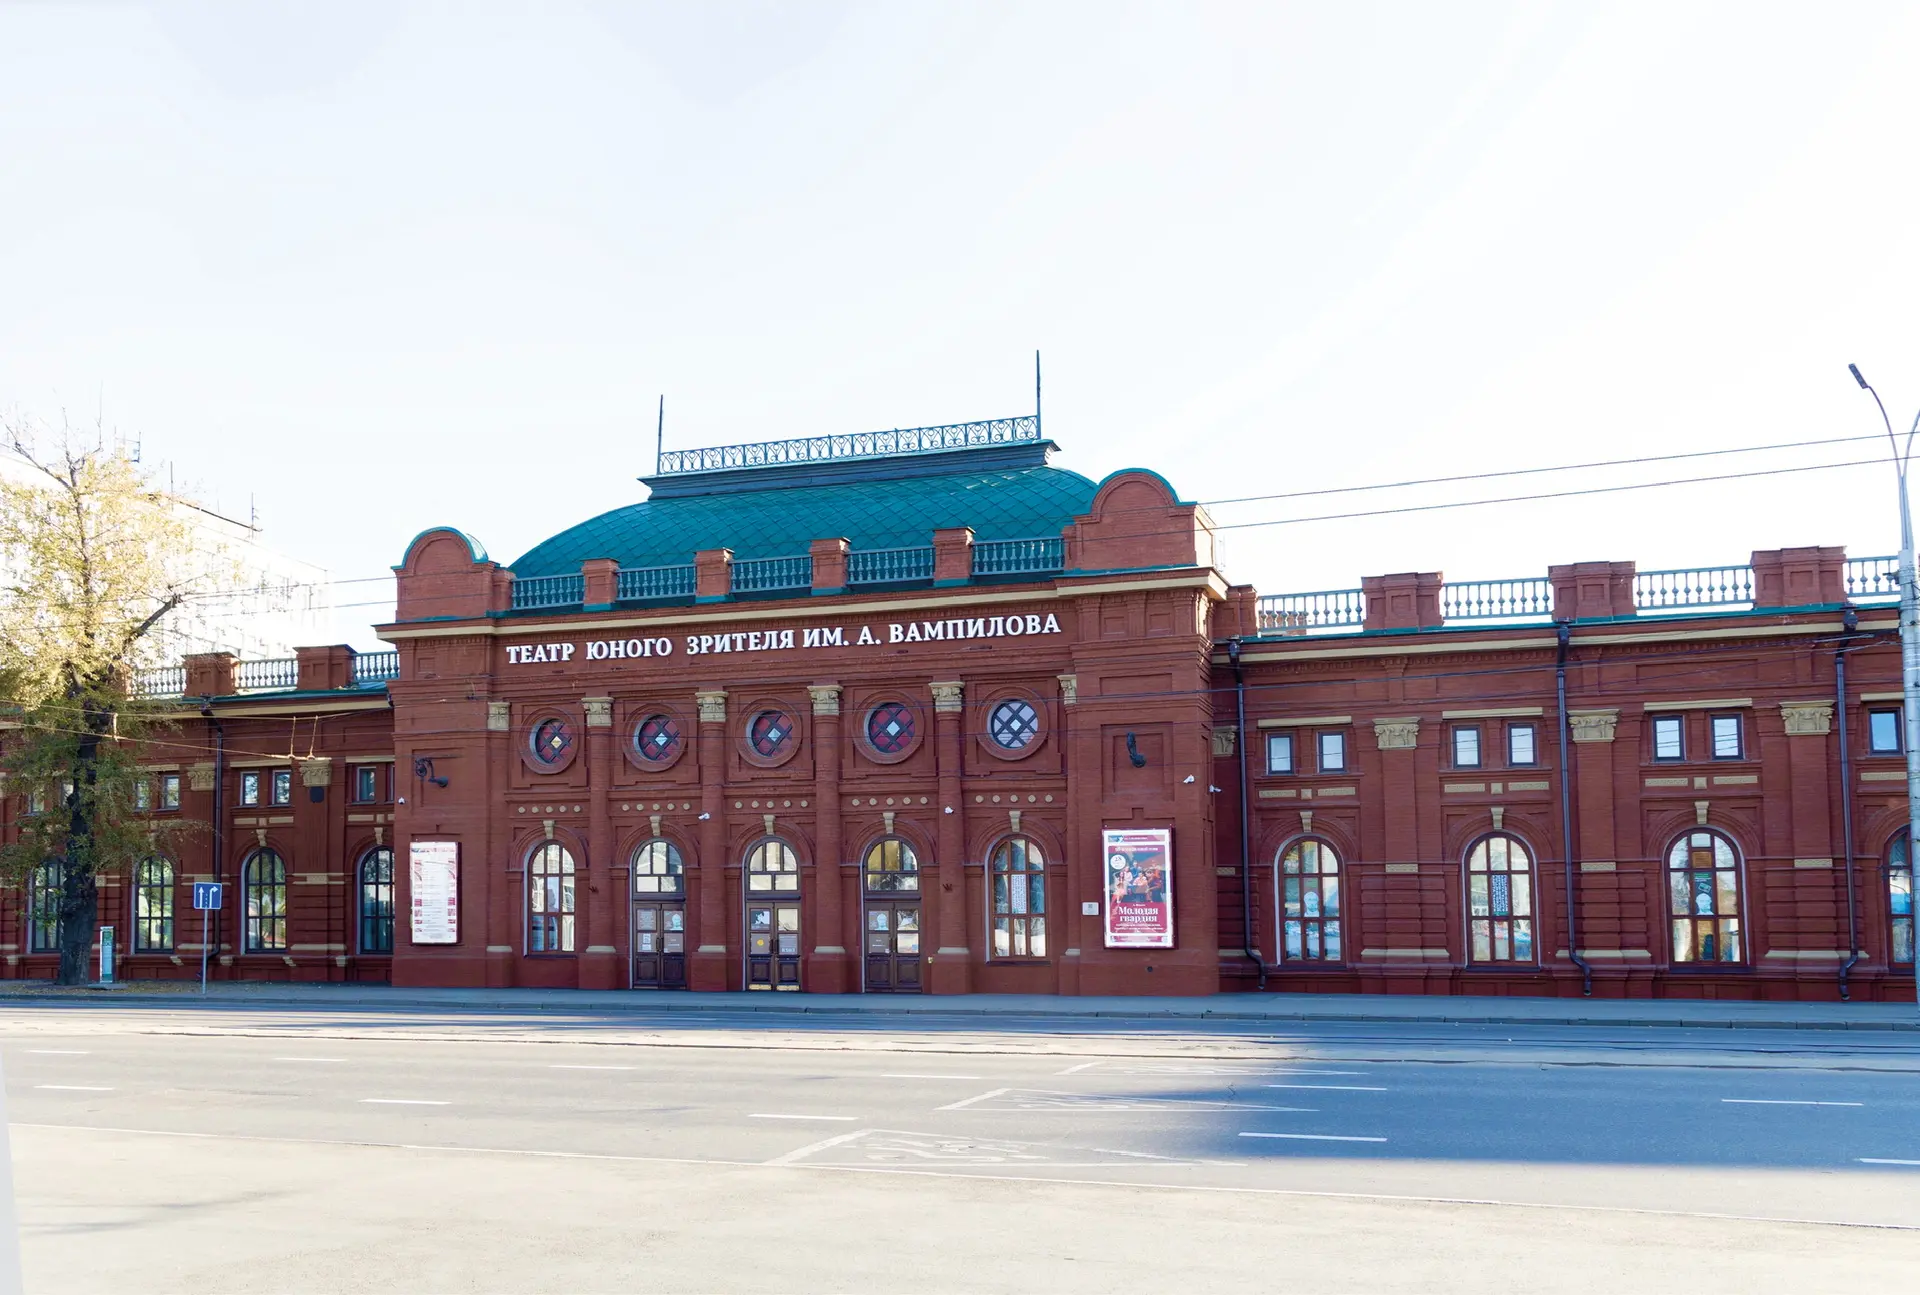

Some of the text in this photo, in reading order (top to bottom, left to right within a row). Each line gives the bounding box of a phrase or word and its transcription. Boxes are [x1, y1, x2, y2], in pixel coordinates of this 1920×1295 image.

[506, 614, 1061, 663] ТЕАТР ЮНОГО ЗРИТЕЛЯ ИМ. А. ВАМПИЛОВА
[1118, 906, 1159, 915] Молодая
[1119, 915, 1157, 923] гвардия
